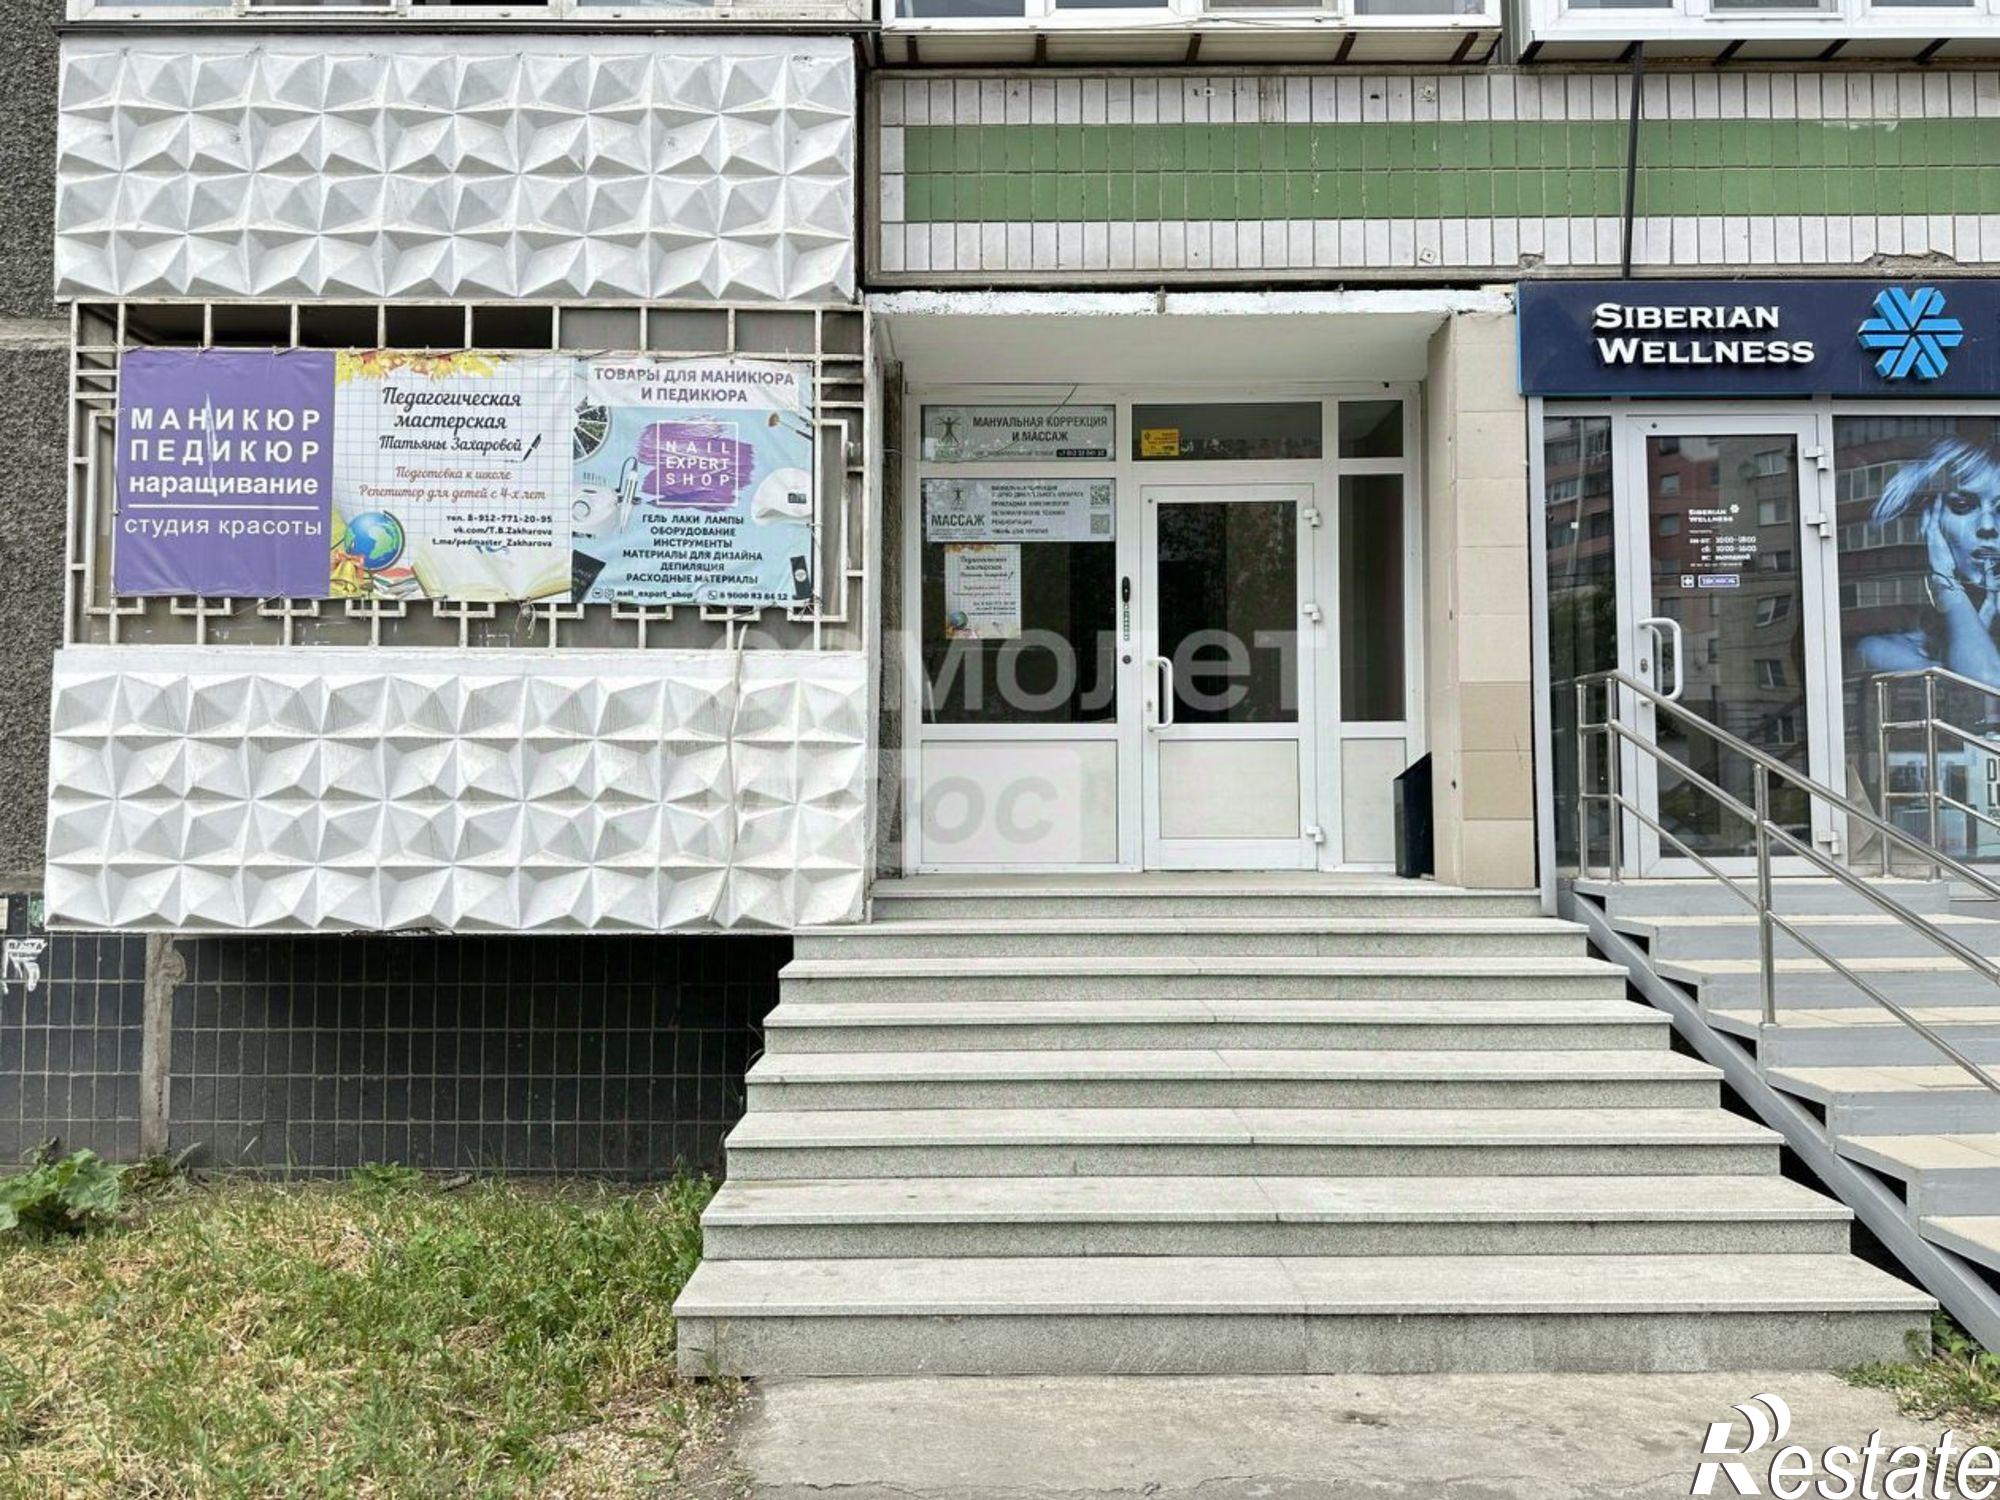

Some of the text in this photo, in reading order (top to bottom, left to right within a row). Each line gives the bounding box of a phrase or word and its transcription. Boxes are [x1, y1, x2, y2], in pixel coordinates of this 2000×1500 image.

[1594, 303, 1780, 329] SIBERIAN
[1597, 337, 1815, 364] WELLNESS
[594, 367, 795, 385] ТОВАРЫ ДЛЯ МАНИКЮРА
[381, 387, 522, 413] Педагогическая
[641, 387, 748, 402] И ПЕДИКЮРА
[131, 408, 320, 431] МАНИКЮР
[393, 413, 507, 436] мастерская
[972, 416, 1108, 429] МАНУАЛЬНАЯ КОРРЕКЦИЯ
[1012, 431, 1069, 442] И МАССАЖ
[130, 439, 320, 466] ПЕДИКЮР
[378, 435, 522, 456] Татьяны Захаровой
[665, 441, 730, 454] NAIL
[665, 457, 730, 470] EXPERT
[395, 466, 512, 483] Подготовка к школе
[665, 473, 730, 486] SHOP
[129, 475, 319, 498] наращивание
[359, 484, 425, 502] Репетитор
[426, 488, 450, 503] для
[452, 487, 488, 503] детей
[522, 490, 546, 500] лет
[642, 514, 744, 525] ГЕЛЬ ЛАКИ ЛАМПЫ
[931, 514, 985, 527] МАССАЖ
[125, 518, 322, 539] студия красоты
[650, 527, 736, 538] ОБОРУДОВАНИЕ
[653, 539, 732, 549] ИНСТРУМЕНТЫ
[623, 550, 763, 561] МАТЕРИАЛЫ ДЛЯ ДИЗАЙНА
[660, 562, 725, 573] ДЕПИЛЯЦИЯ
[626, 573, 758, 584] РАСХОДНЫЕ МАТЕРИАЛЫ
